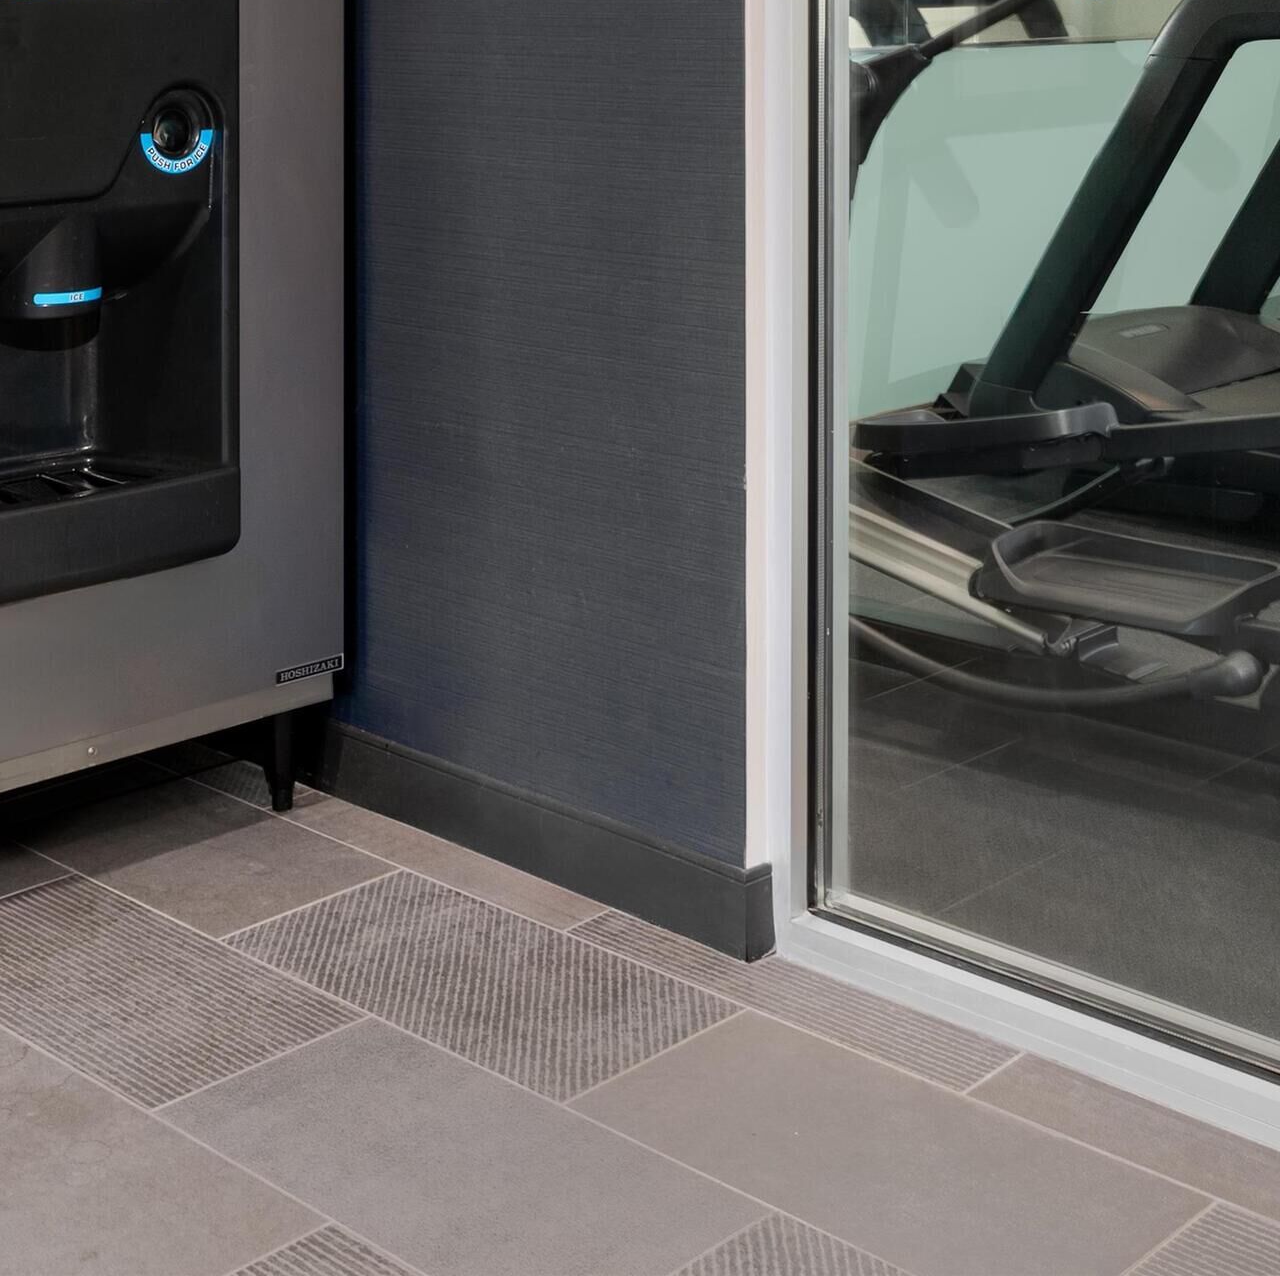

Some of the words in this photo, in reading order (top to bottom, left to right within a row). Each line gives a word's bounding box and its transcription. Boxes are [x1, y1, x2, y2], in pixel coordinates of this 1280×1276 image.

[147, 147, 170, 170] PUSH
[174, 158, 194, 170] FOR
[194, 143, 207, 160] ICE
[70, 293, 84, 301] ICE
[279, 658, 339, 682] HOSHIZAKI
